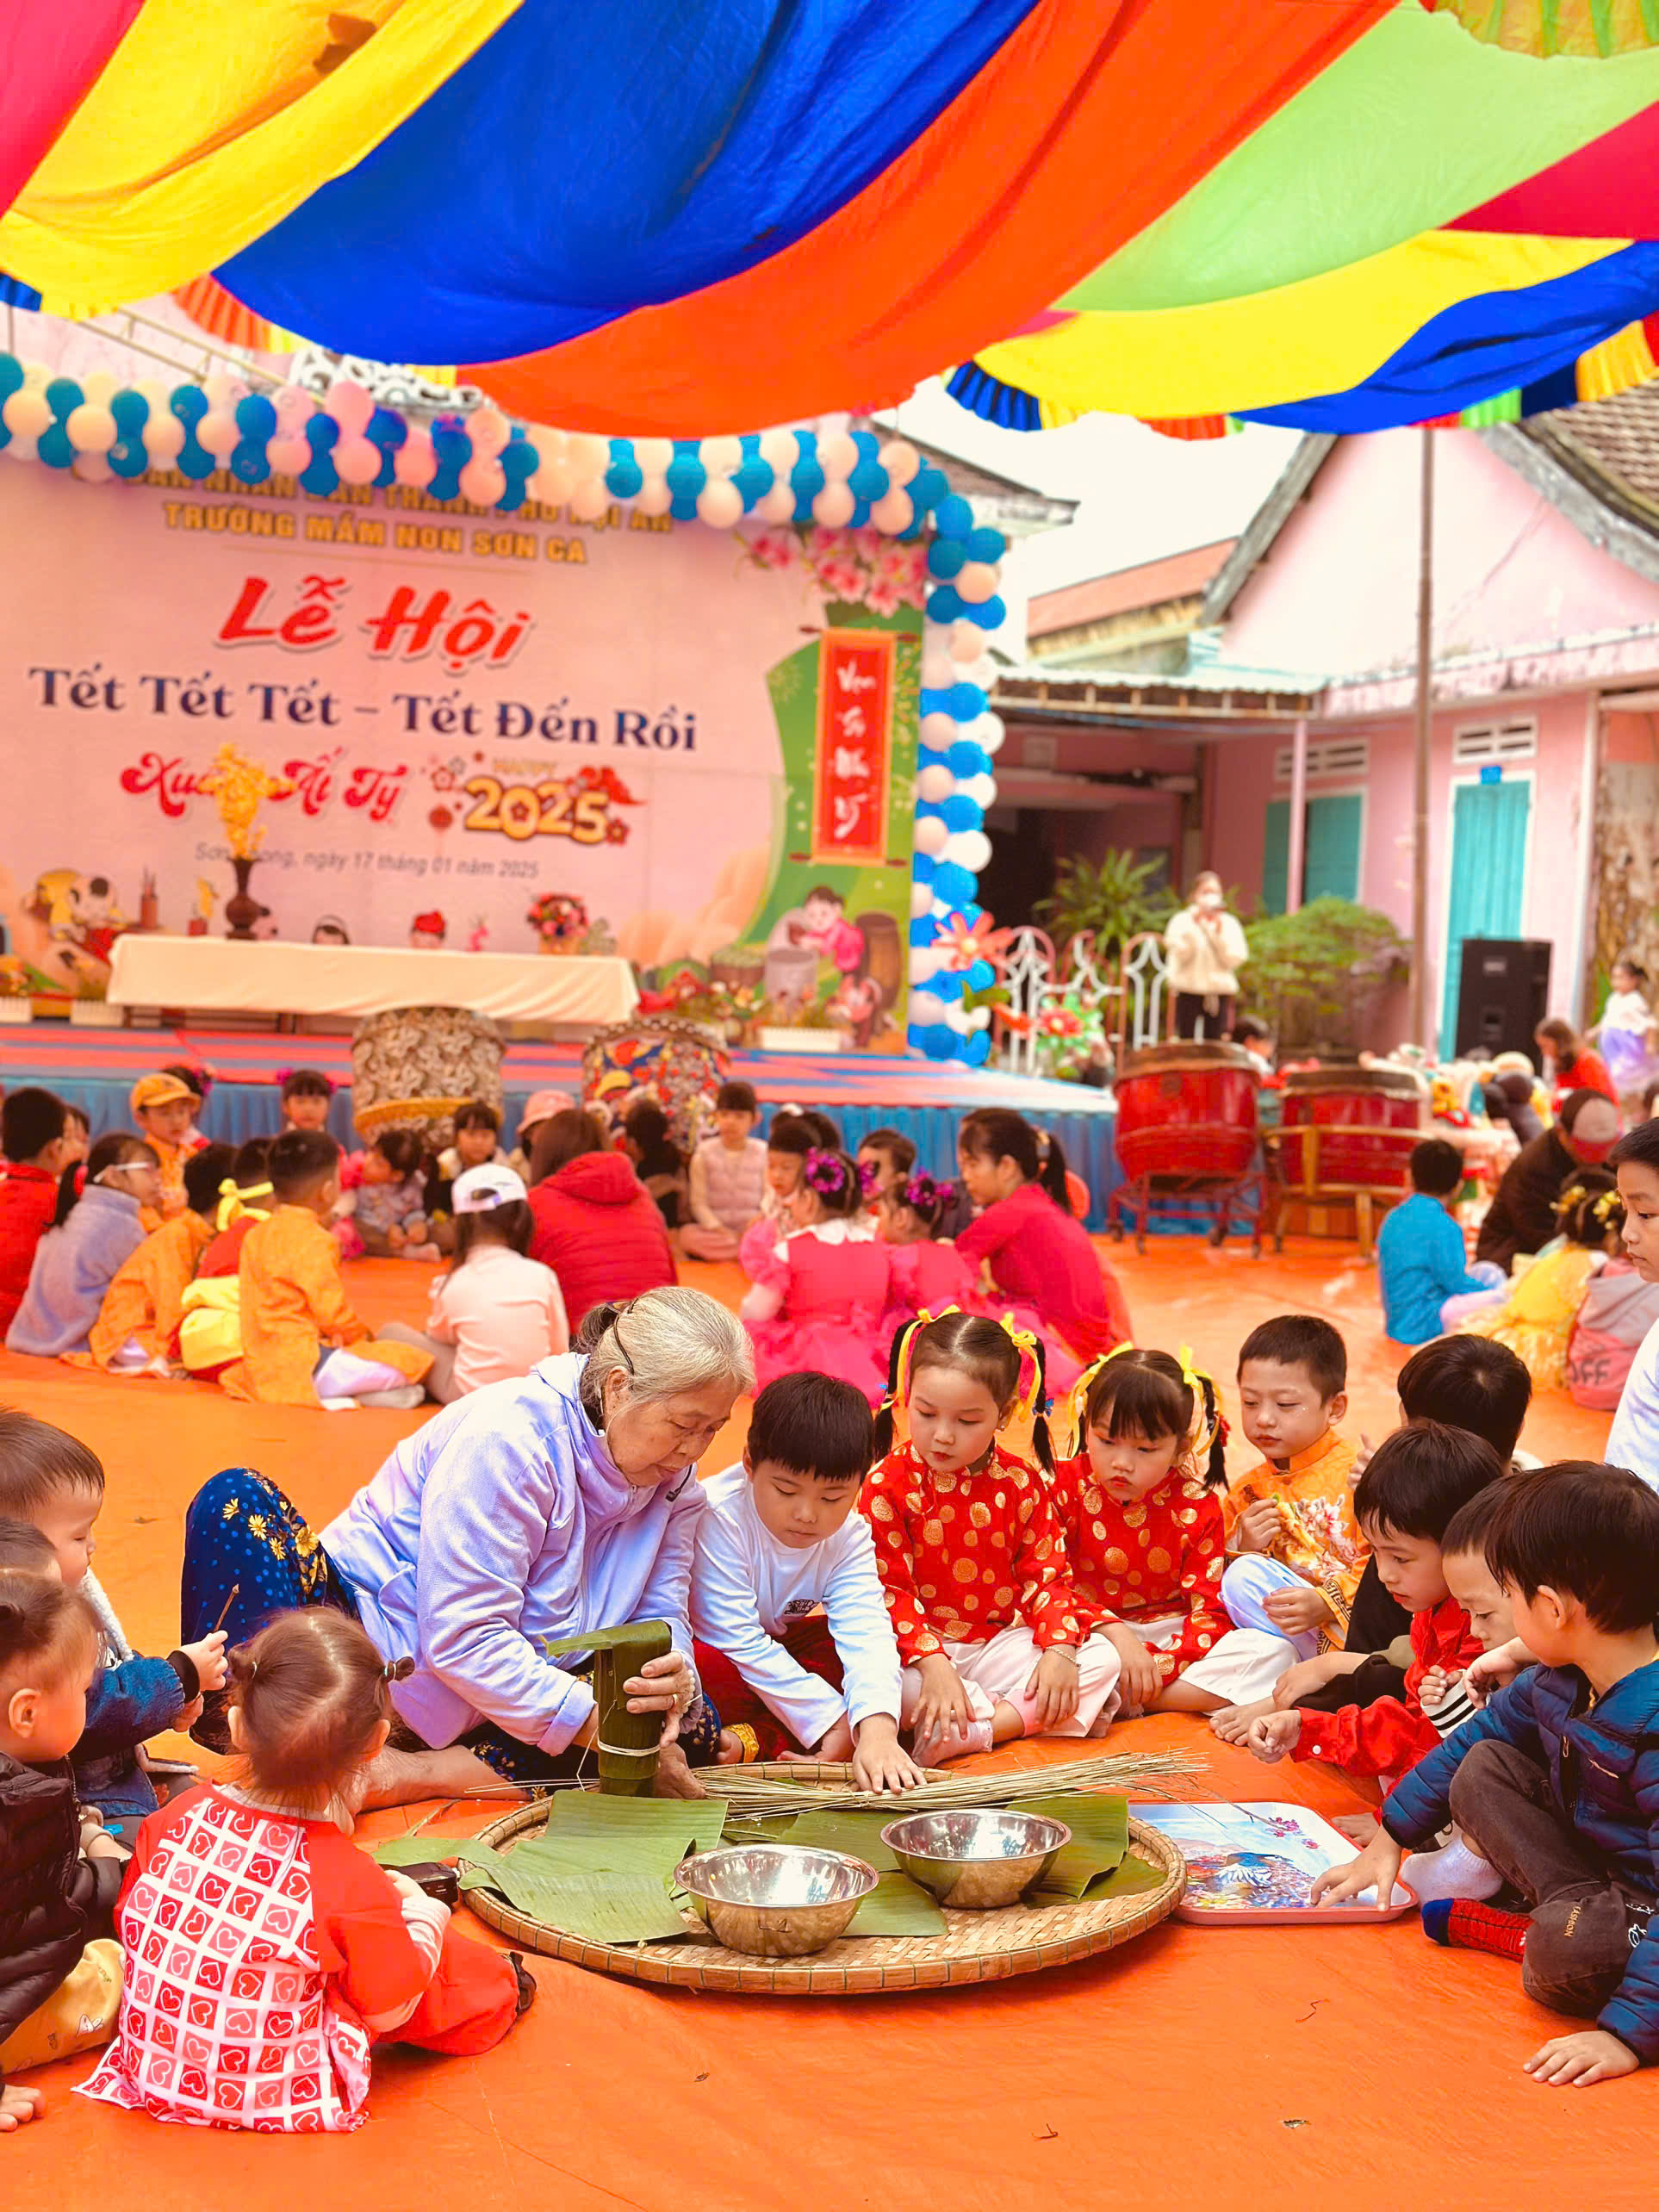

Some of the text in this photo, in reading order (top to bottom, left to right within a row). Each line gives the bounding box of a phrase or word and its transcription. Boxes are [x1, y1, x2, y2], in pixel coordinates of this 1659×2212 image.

[163, 501, 295, 539] TRƯỜNG
[395, 523, 463, 554] NON
[473, 531, 538, 560] SƠN
[545, 537, 589, 564] CA
[214, 573, 536, 676] Lễ Hội
[28, 662, 126, 711] Tết
[140, 671, 234, 718] Tết
[247, 679, 340, 726] Tết
[393, 690, 482, 736] Tết
[495, 697, 600, 743] Đến
[614, 705, 698, 752] Rồi
[462, 773, 611, 848] 2025
[354, 851, 376, 870] 17
[498, 859, 539, 879] 2025
[1563, 1904, 1582, 1937] FASHION
